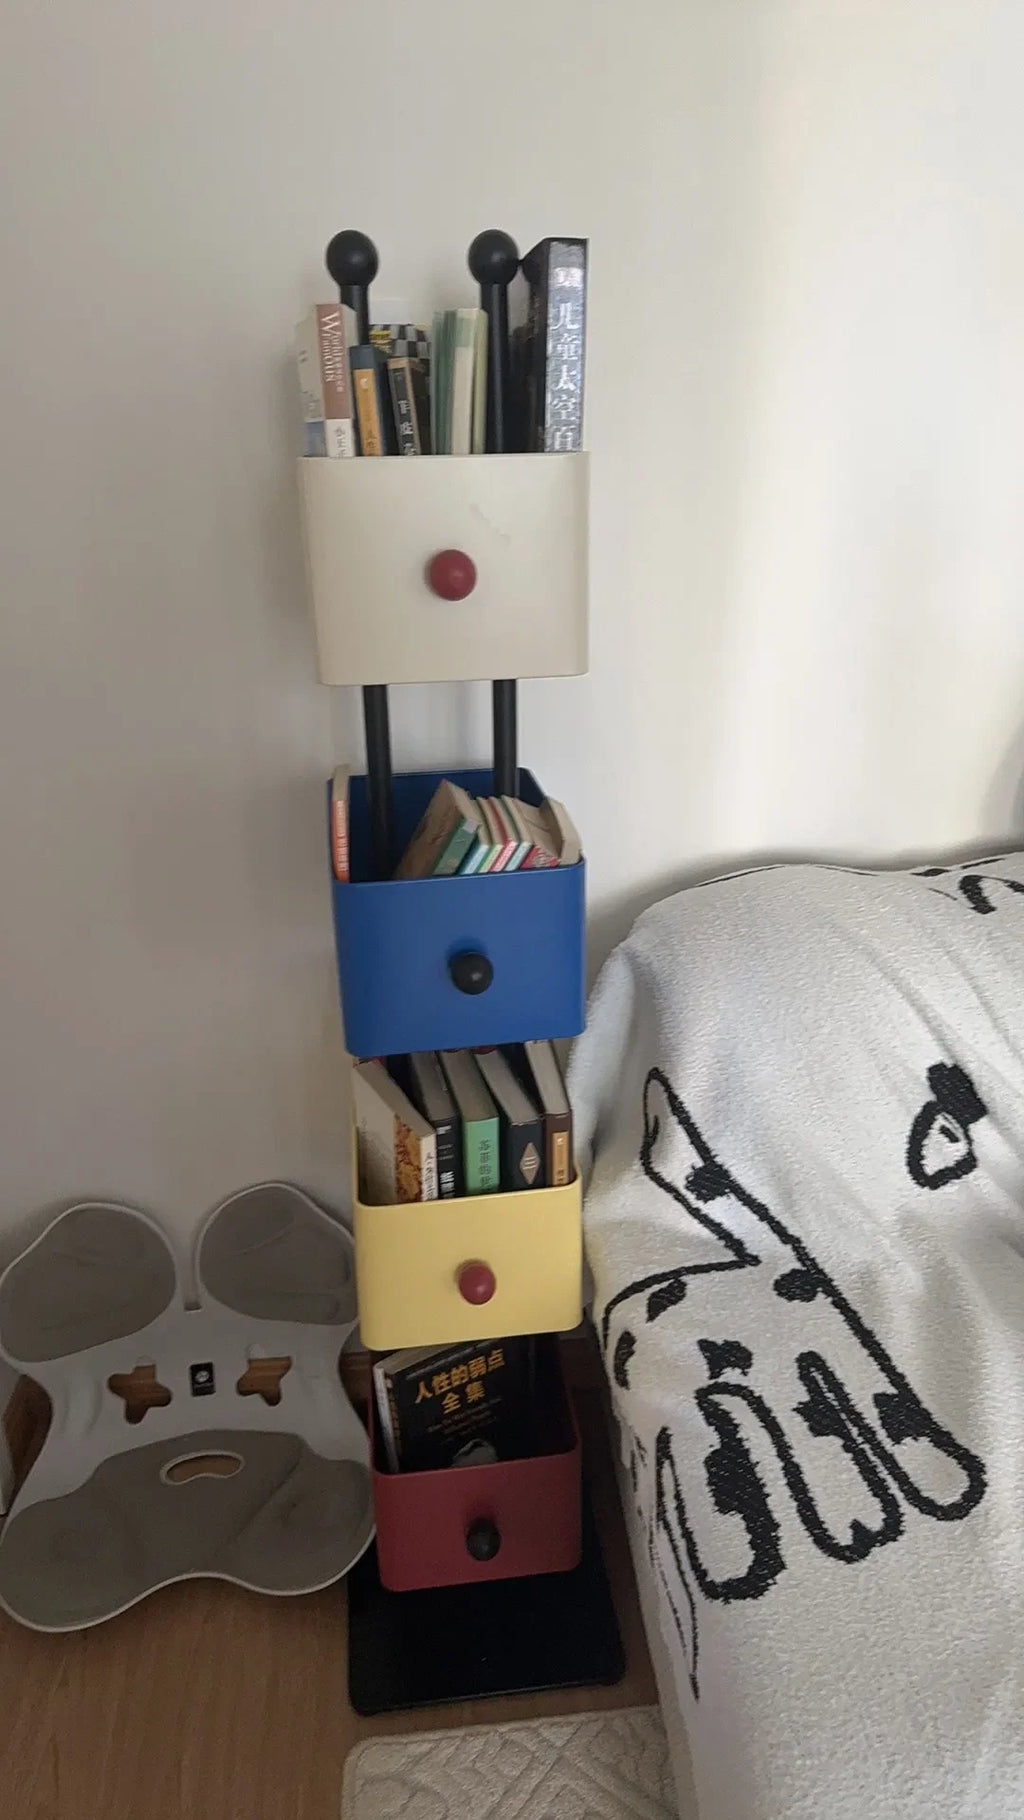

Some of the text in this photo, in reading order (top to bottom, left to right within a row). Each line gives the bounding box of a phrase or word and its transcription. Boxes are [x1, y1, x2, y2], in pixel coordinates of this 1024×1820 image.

[413, 1348, 505, 1405] 人性的弱点
[441, 1380, 486, 1415] 全集
